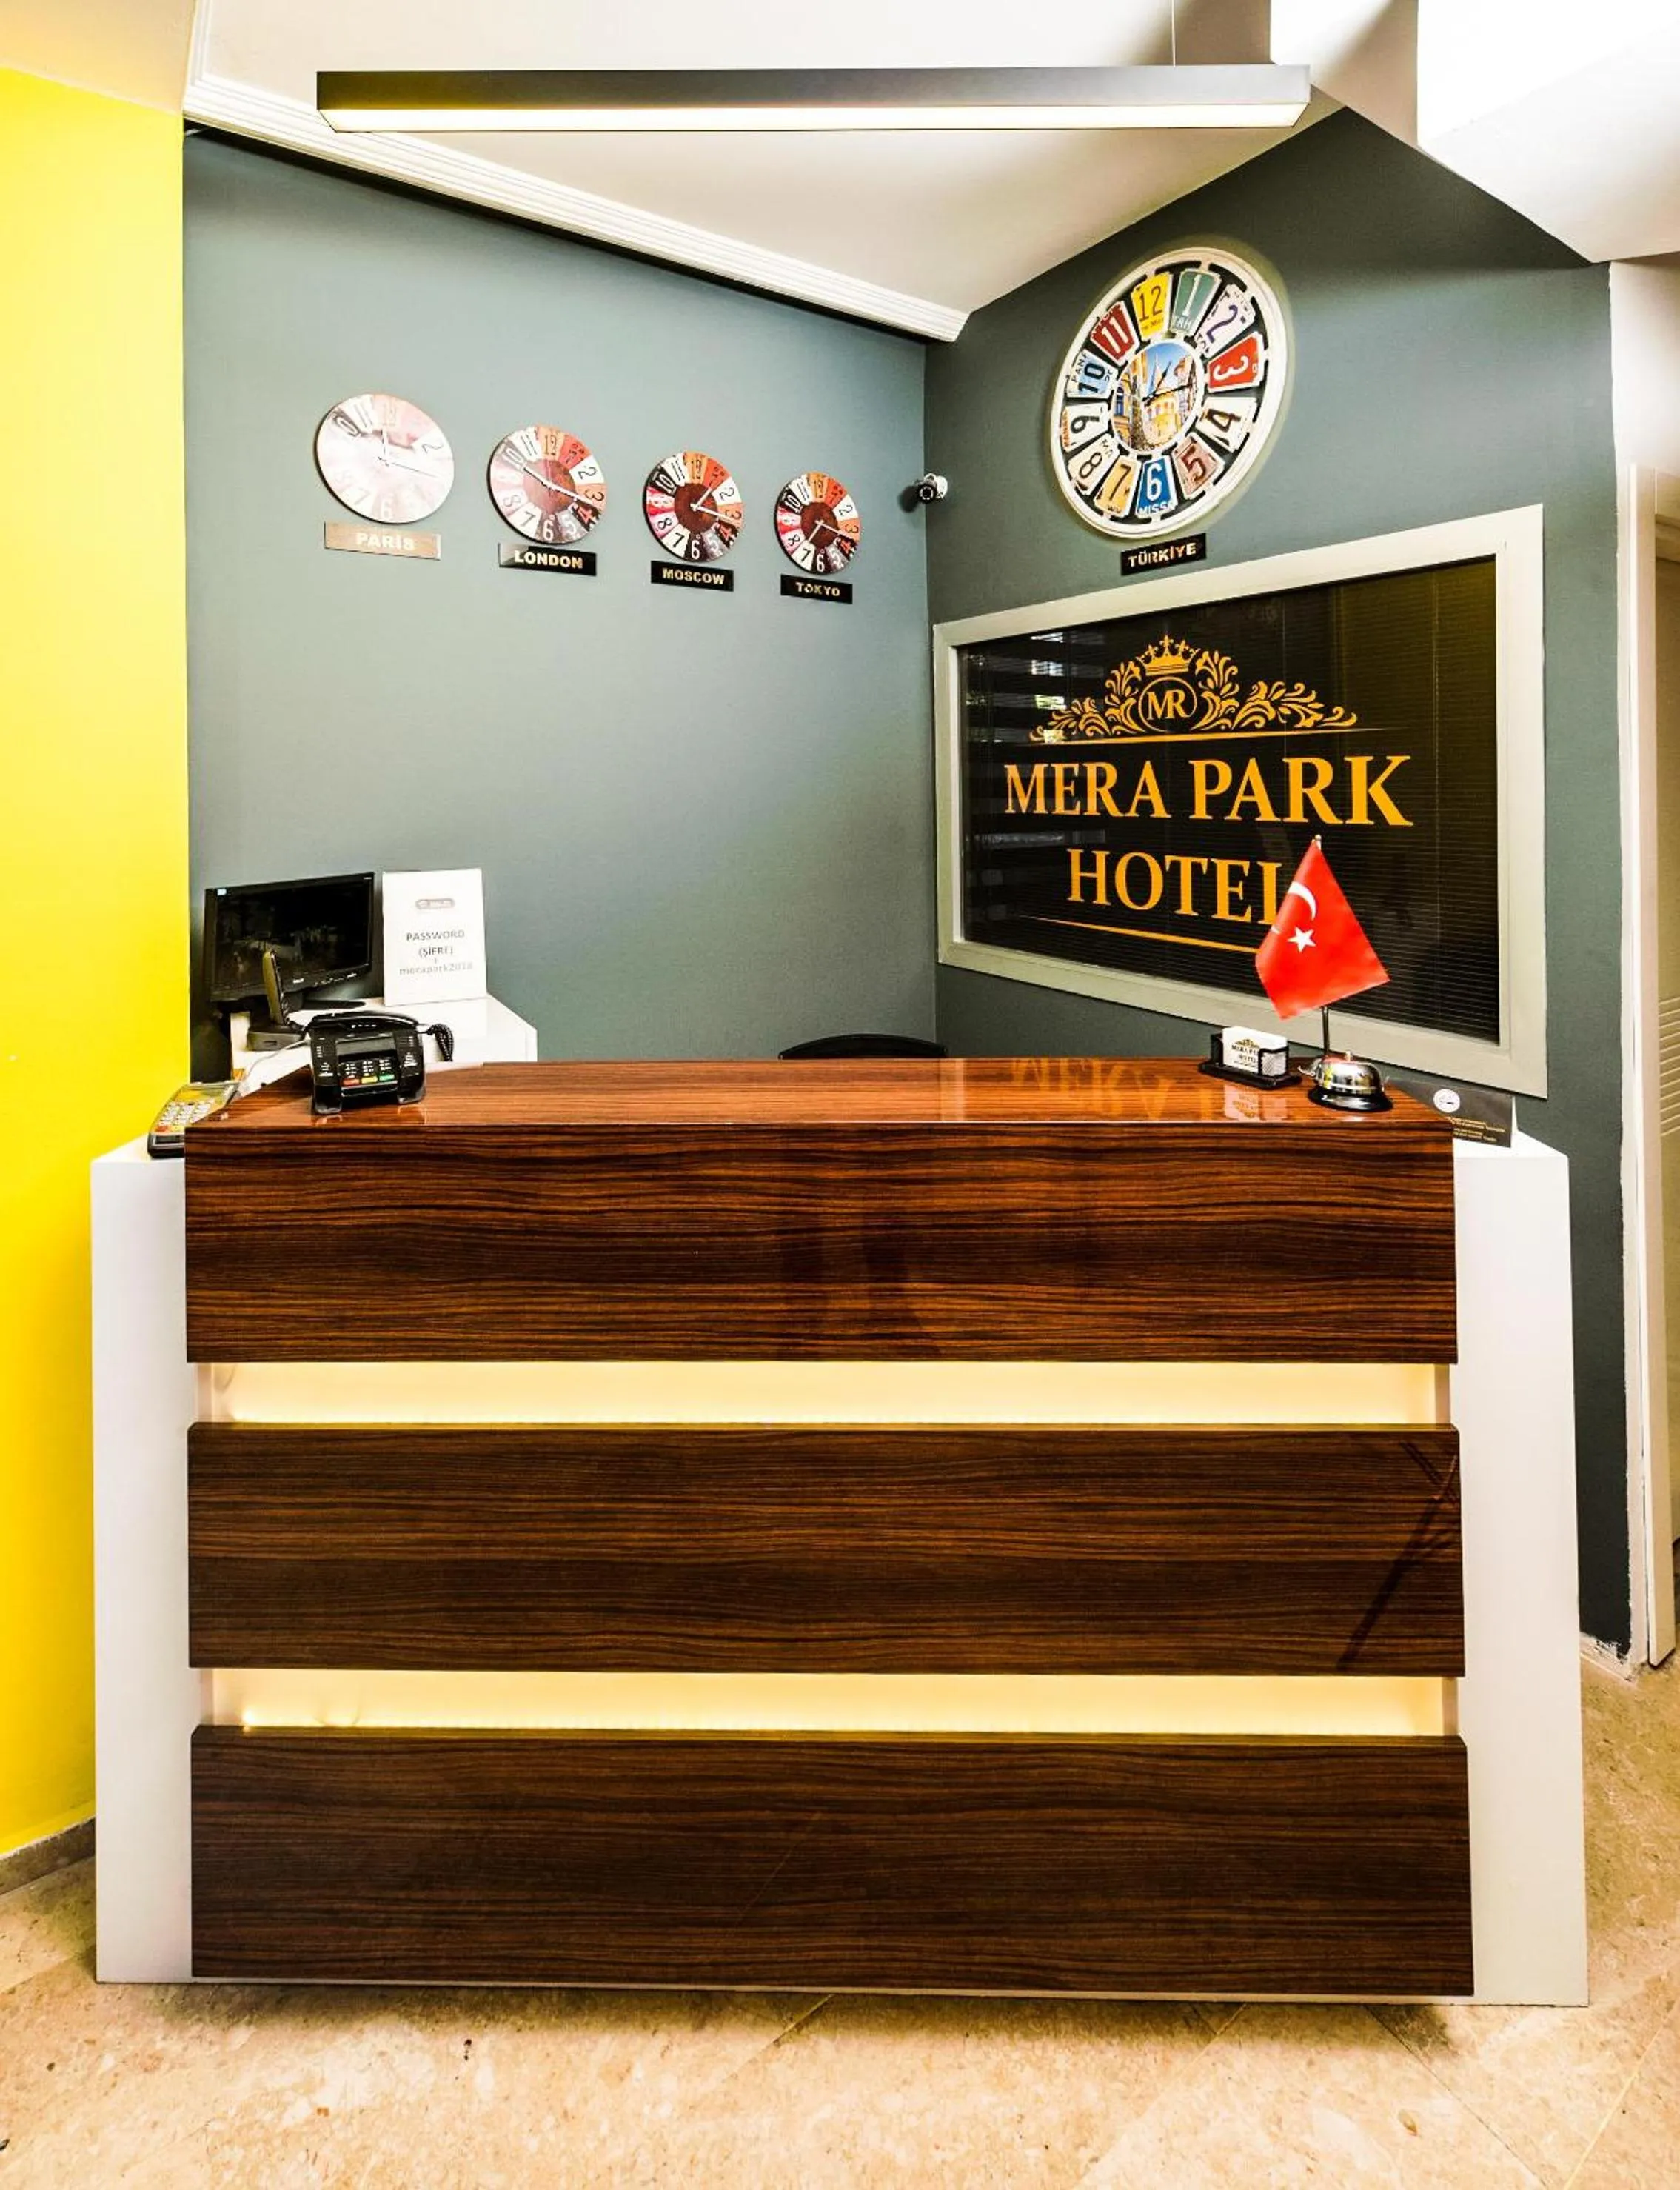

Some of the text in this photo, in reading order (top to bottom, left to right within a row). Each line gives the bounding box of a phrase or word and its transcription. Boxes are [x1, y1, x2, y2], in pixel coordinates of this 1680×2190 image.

[1139, 285, 1162, 321] 12
[1182, 275, 1202, 316] 1
[1206, 304, 1238, 343] 2
[1102, 316, 1128, 353] 11
[1078, 363, 1105, 393] 10
[1213, 355, 1249, 381] 3
[1071, 415, 1100, 434] 9
[1205, 409, 1241, 433] 4
[521, 433, 538, 455] 11
[544, 434, 557, 455] 12
[1079, 453, 1102, 478] 8
[1180, 445, 1207, 481] 5
[578, 467, 597, 480] 2
[1109, 464, 1132, 501] 7
[1147, 463, 1162, 501] 6
[585, 487, 605, 501] 3
[655, 474, 677, 495] 10
[719, 487, 735, 501] 2
[503, 494, 521, 507] 8
[785, 494, 803, 514] 10
[839, 504, 853, 516] 2
[521, 511, 536, 527] 7
[561, 514, 578, 535] 5
[657, 518, 672, 530] 8
[845, 524, 859, 534] 3
[543, 519, 554, 541] 6
[673, 532, 685, 548] 7
[691, 540, 700, 560] 6
[707, 533, 720, 550] 5
[788, 534, 800, 547] 8
[514, 550, 583, 569] LONDON
[801, 549, 811, 562] 7
[817, 554, 825, 572] 6
[1128, 543, 1197, 568] TÜRKİYE
[662, 567, 725, 585] MOSCOW
[795, 581, 840, 596] TOKYO
[1146, 689, 1188, 721] MR
[1004, 755, 1413, 826] MERA PARK
[1067, 848, 1282, 925] HOTEL
[406, 929, 465, 941] PASSWORD
